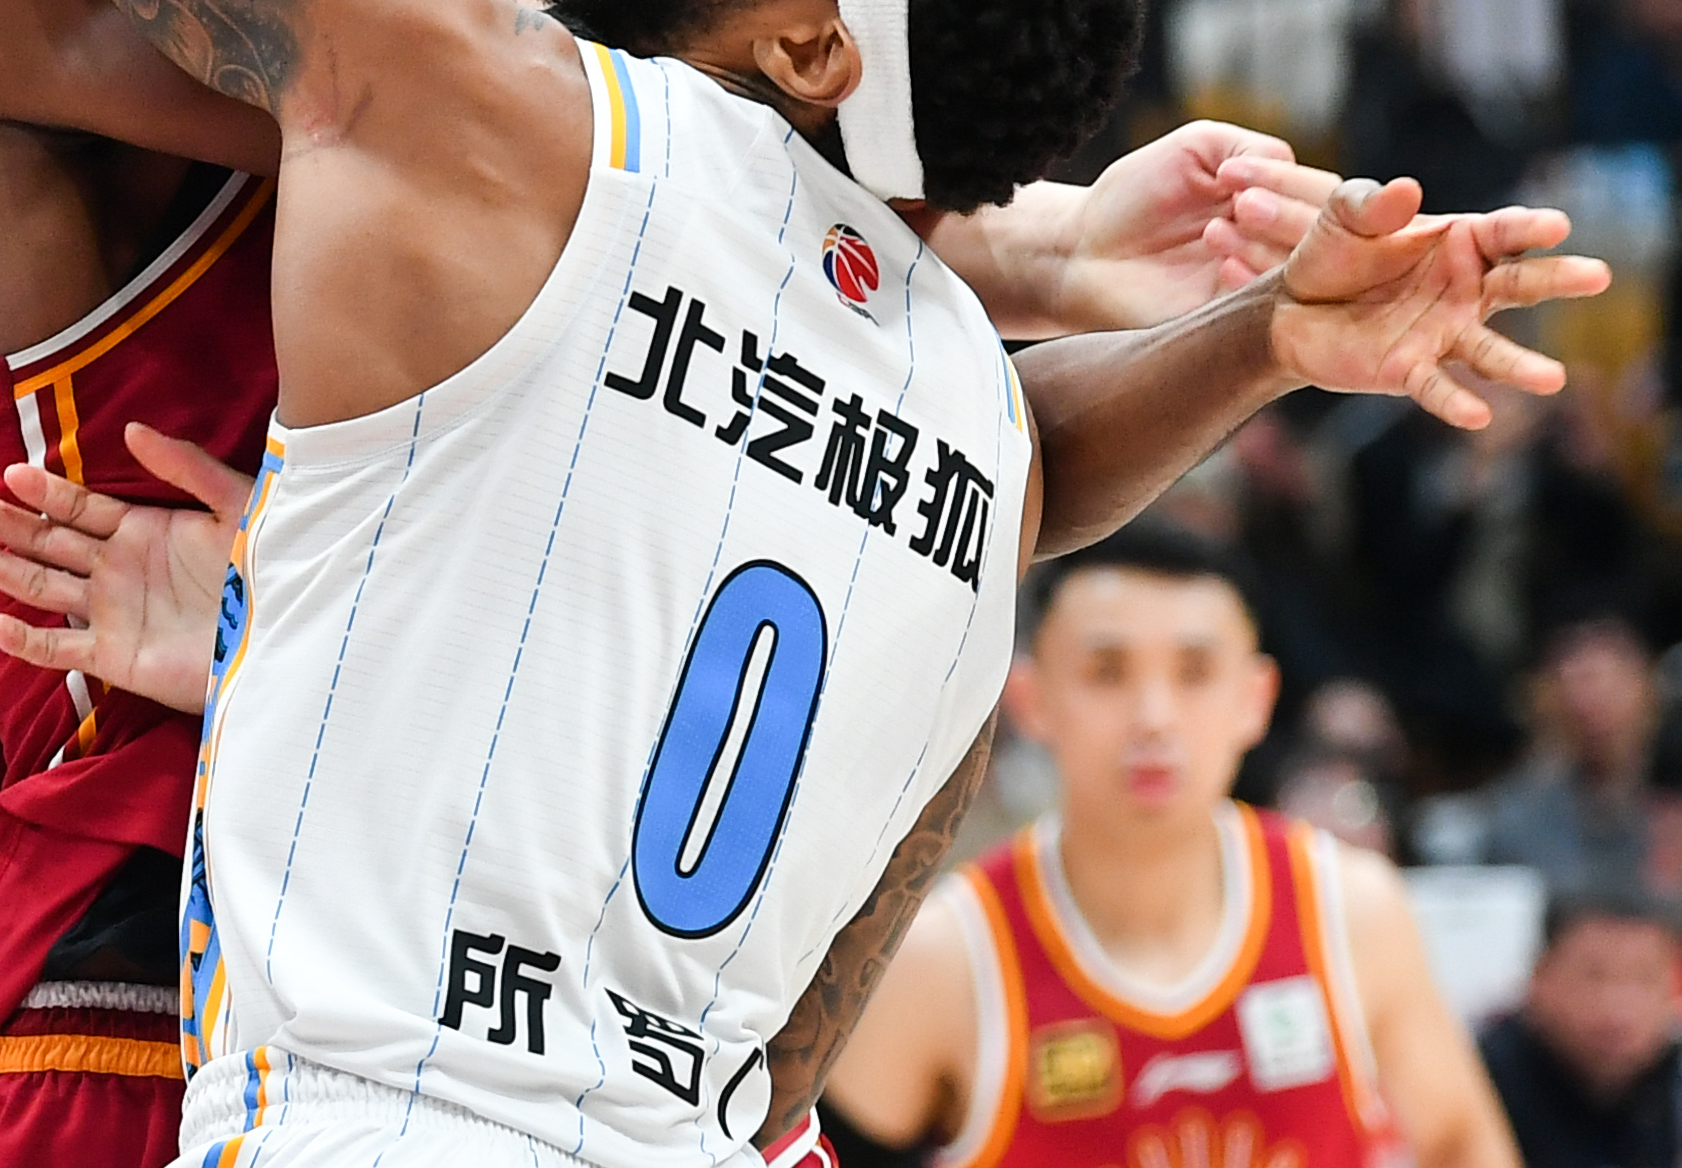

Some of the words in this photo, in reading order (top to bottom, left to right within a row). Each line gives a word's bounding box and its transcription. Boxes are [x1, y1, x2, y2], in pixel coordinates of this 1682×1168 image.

[604, 285, 995, 593] 北汽极狐
[631, 558, 828, 940] 0
